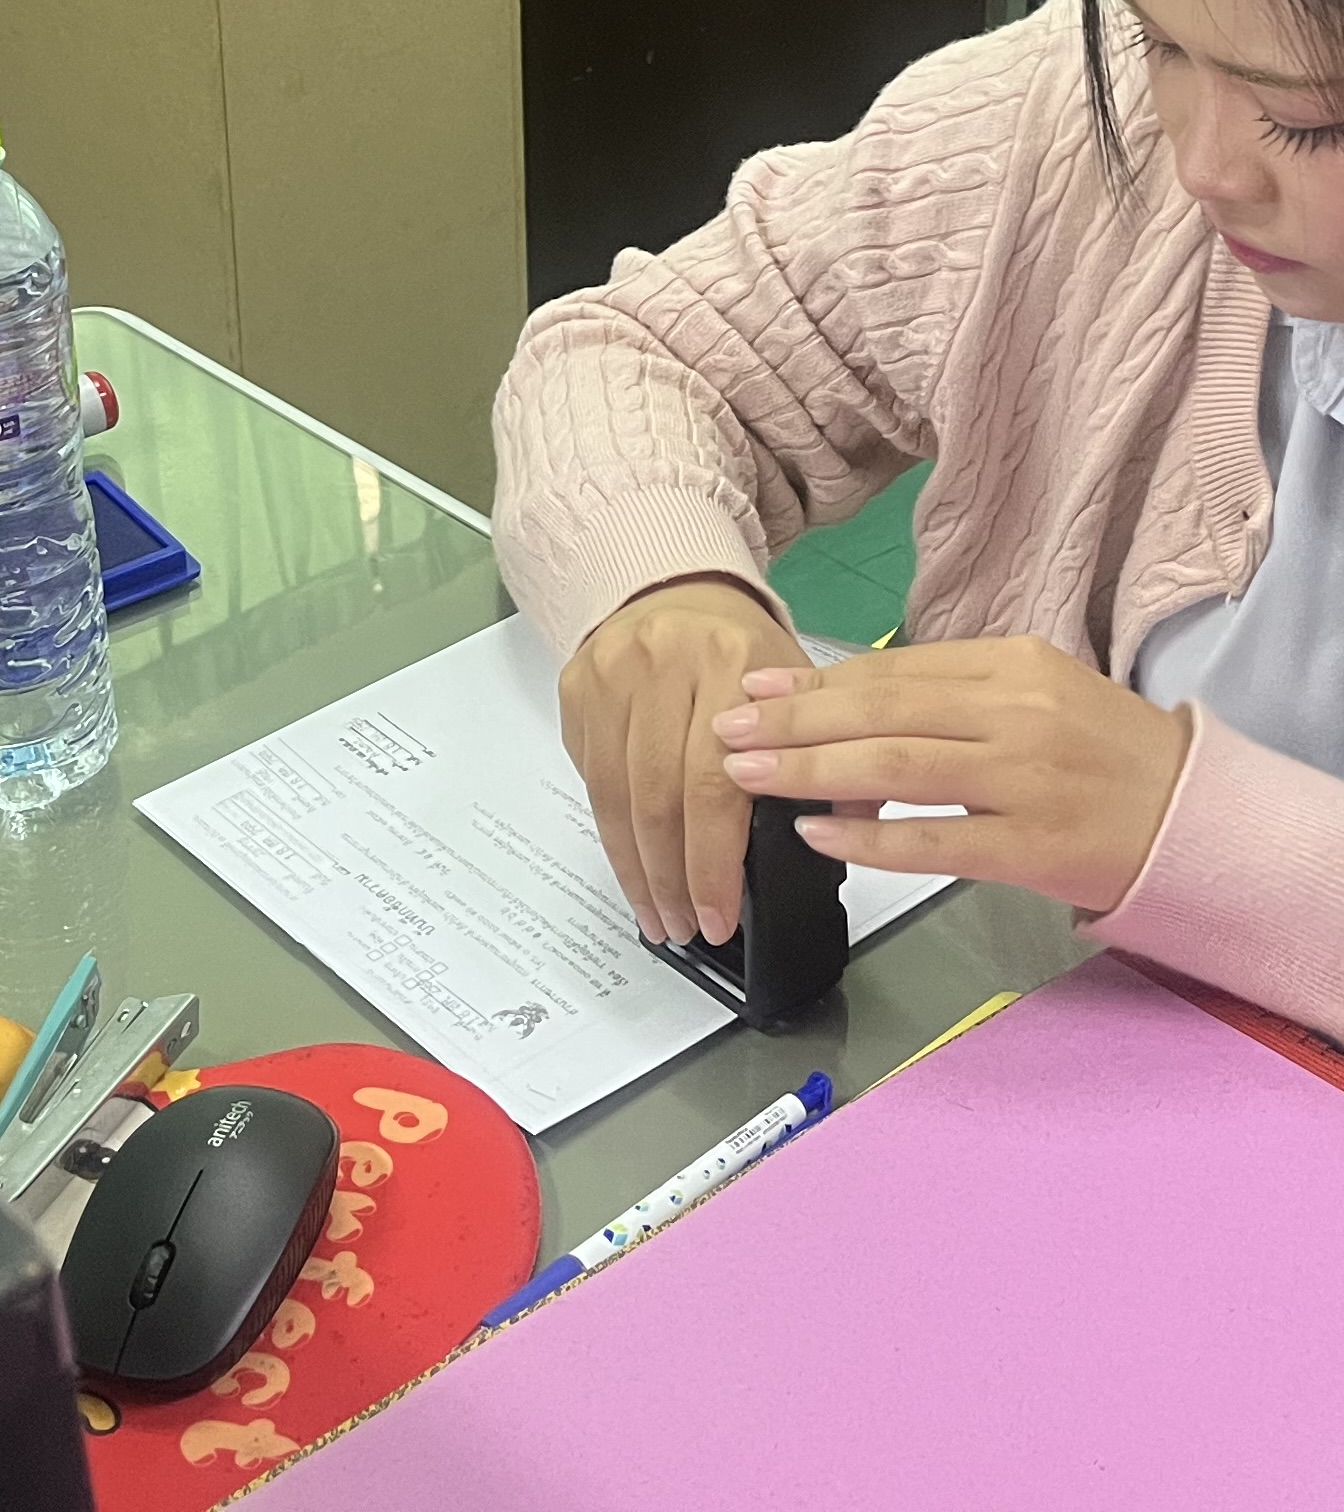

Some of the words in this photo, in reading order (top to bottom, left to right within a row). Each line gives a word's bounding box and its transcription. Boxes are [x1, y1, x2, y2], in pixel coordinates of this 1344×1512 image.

[349, 872, 436, 937] บันทึกข้อความ
[207, 1100, 251, 1147] anitech
